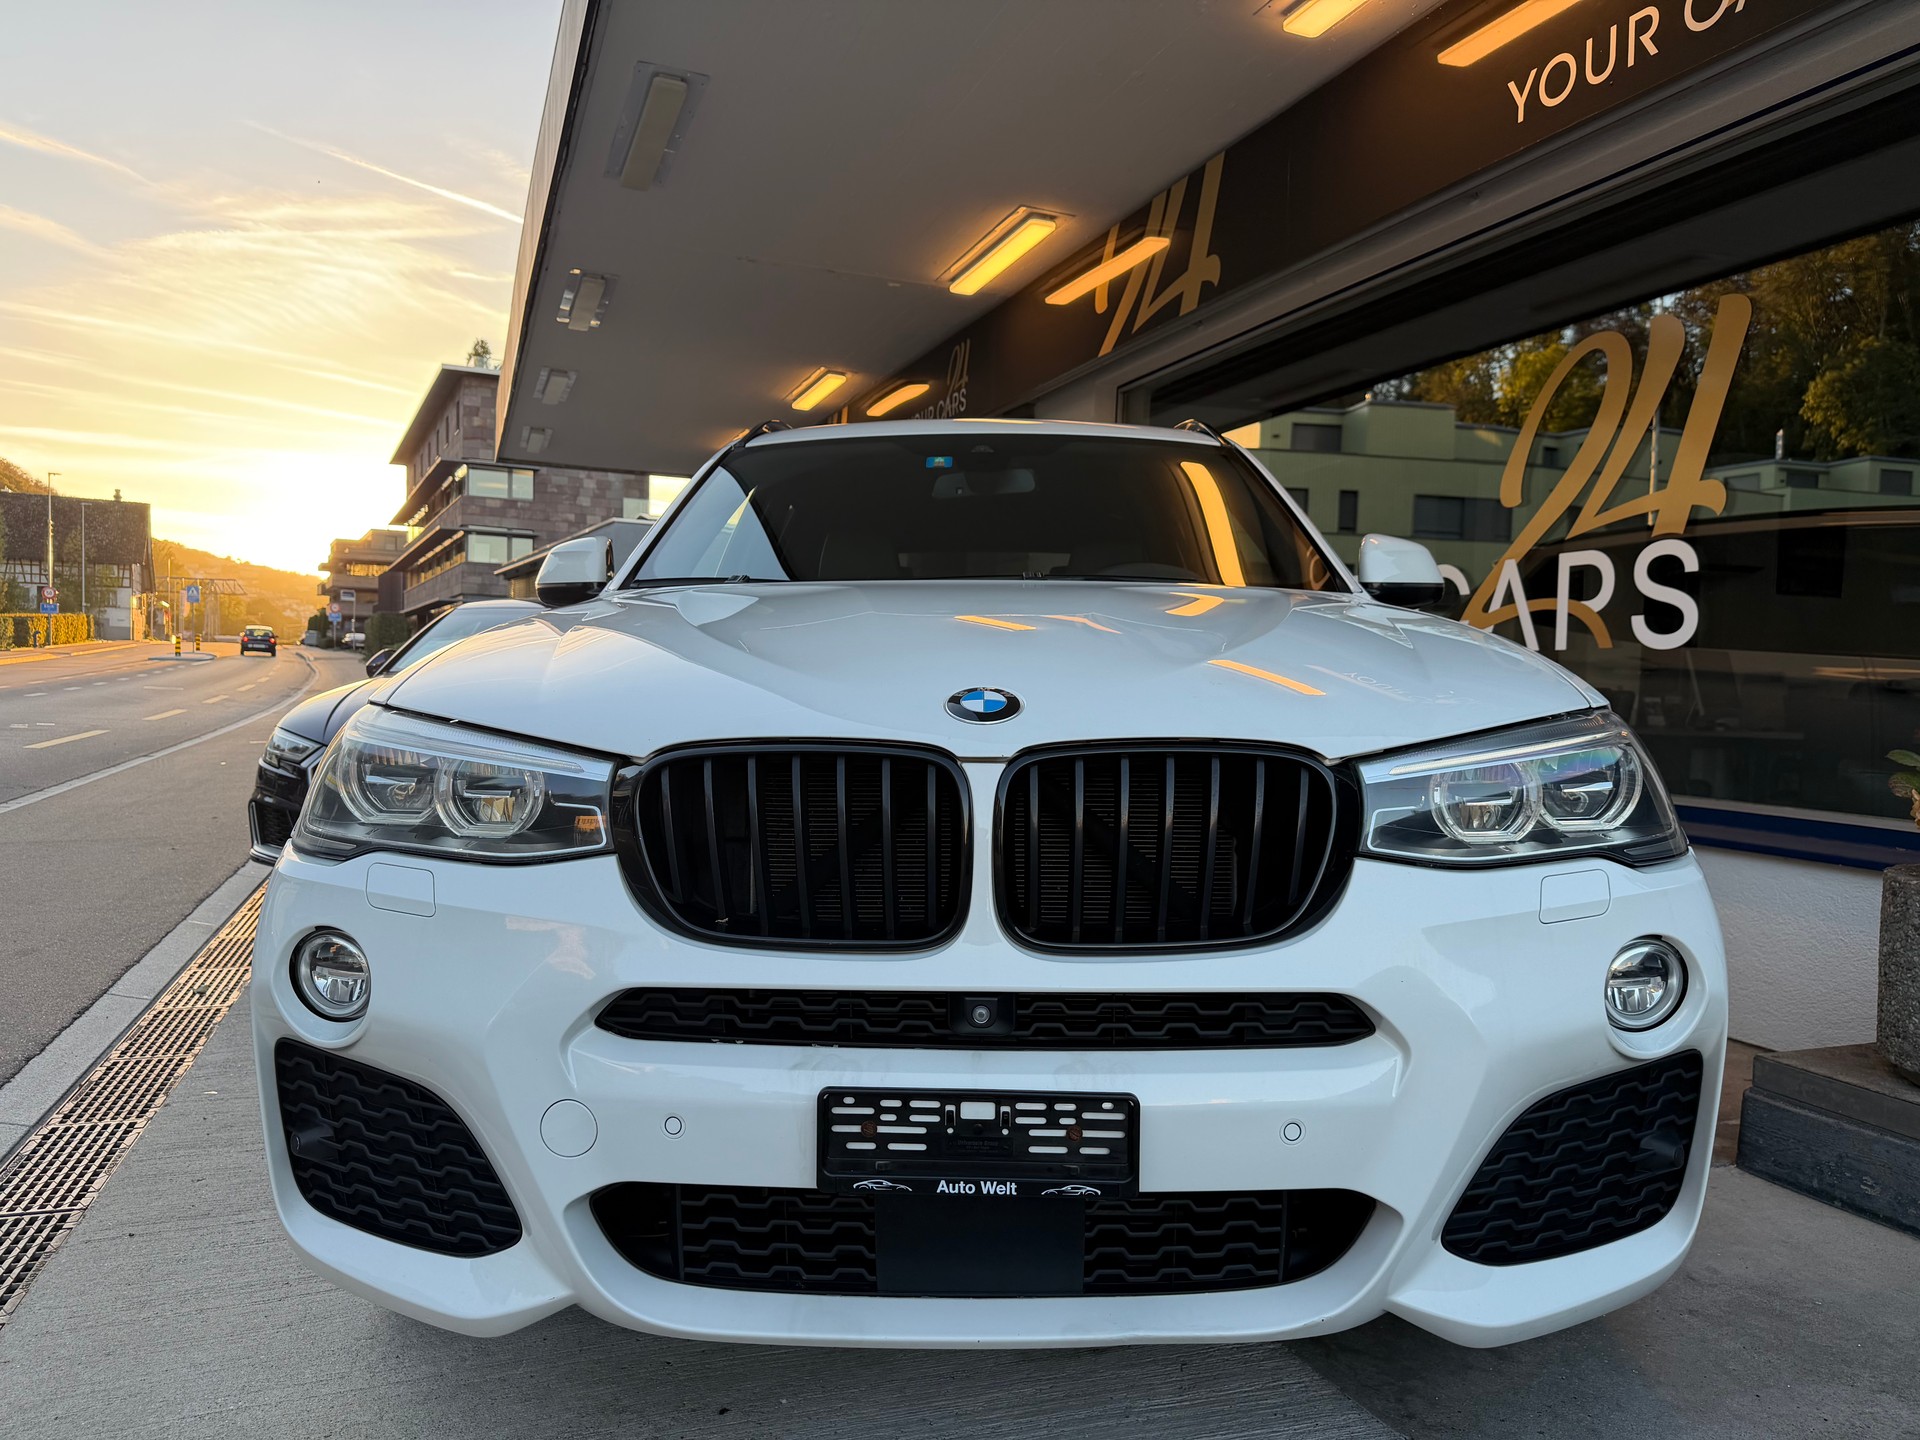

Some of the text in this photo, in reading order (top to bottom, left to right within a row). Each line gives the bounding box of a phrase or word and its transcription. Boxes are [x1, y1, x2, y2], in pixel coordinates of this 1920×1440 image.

[1507, 6, 1660, 123] YOUR
[937, 388, 967, 419] CARS
[1460, 294, 1752, 648] 24
[936, 1180, 1017, 1195] Auto Welt
